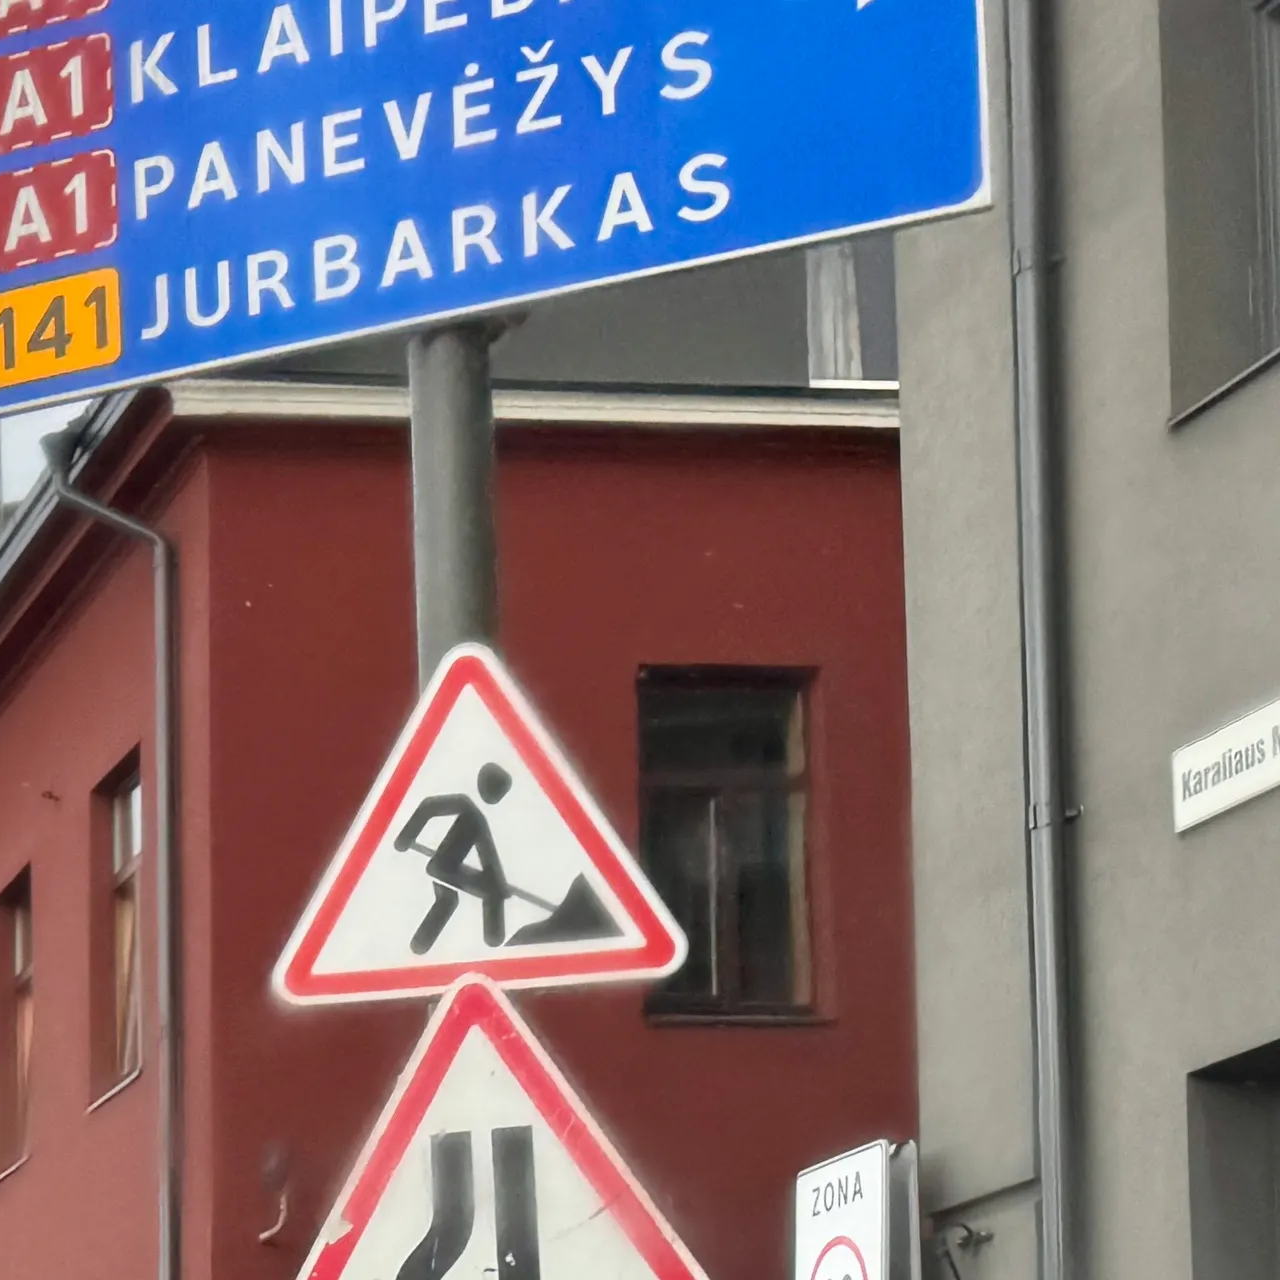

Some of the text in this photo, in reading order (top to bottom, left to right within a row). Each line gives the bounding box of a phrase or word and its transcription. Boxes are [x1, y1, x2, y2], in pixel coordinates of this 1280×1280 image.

[0, 55, 84, 136] A1
[4, 30, 714, 252] A1 PANEVĖŽYS
[141, 153, 731, 341] JURBARKAS
[1181, 737, 1266, 802] Karaliaus
[811, 1171, 864, 1217] ZONA
